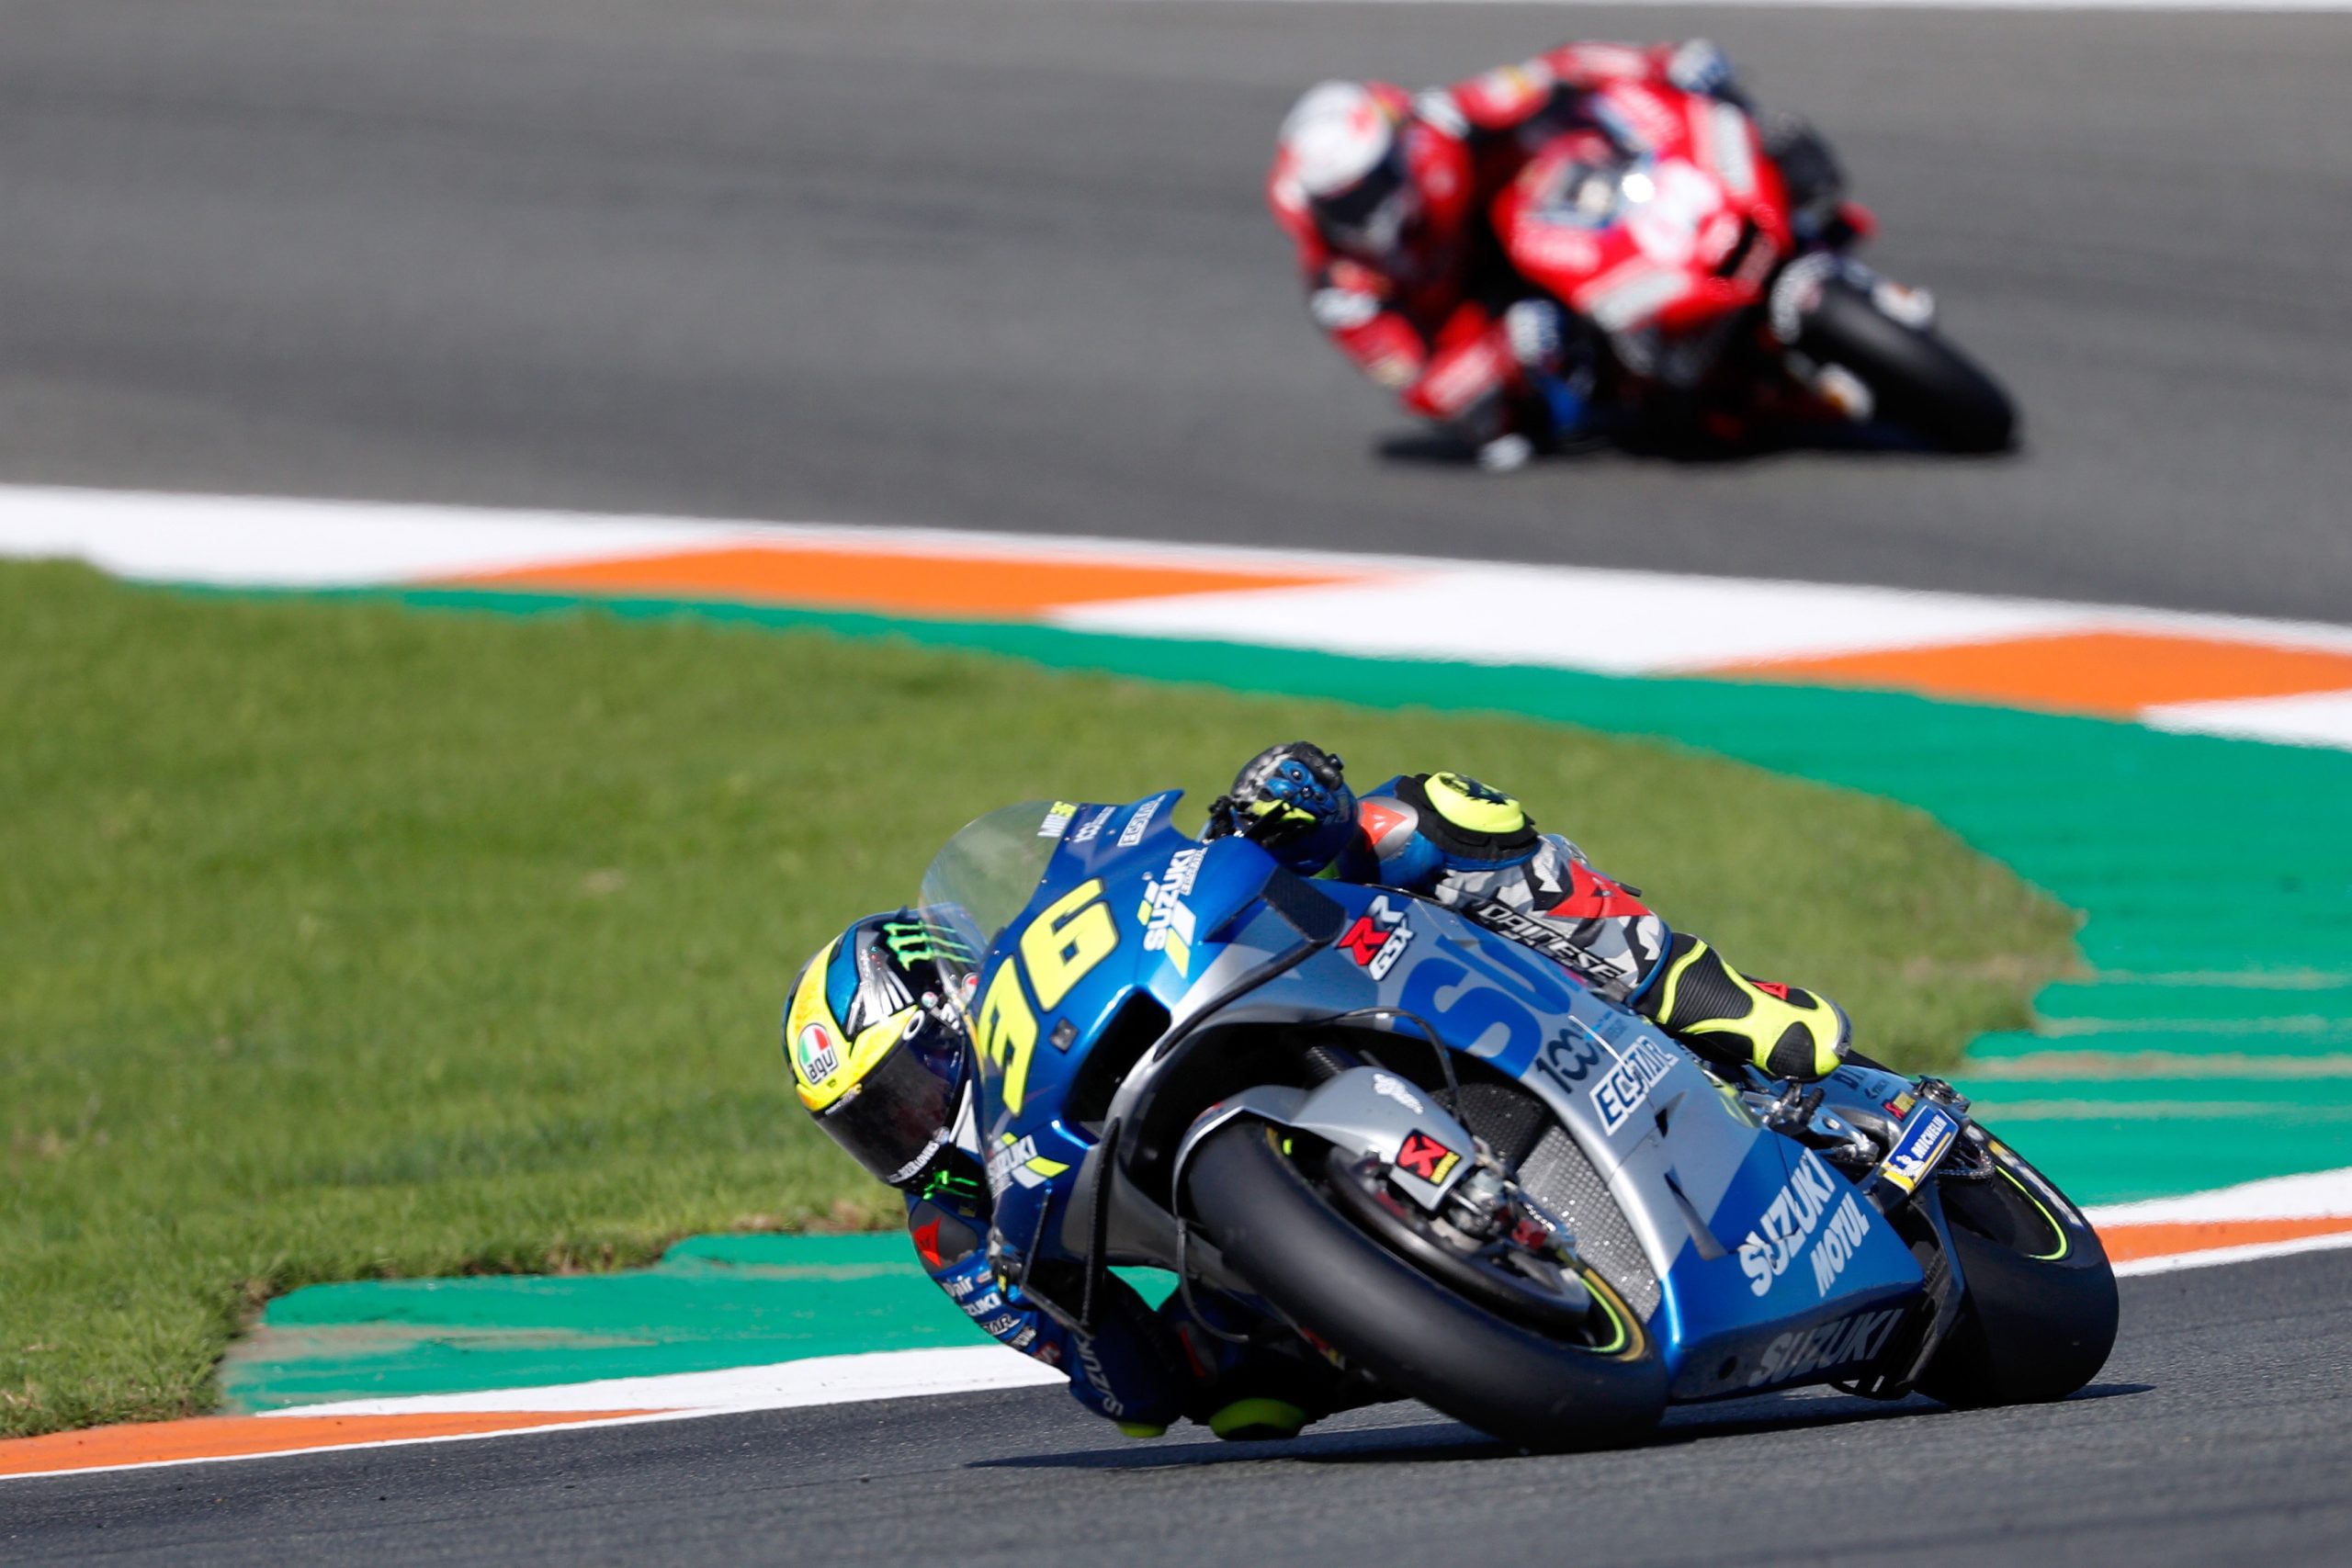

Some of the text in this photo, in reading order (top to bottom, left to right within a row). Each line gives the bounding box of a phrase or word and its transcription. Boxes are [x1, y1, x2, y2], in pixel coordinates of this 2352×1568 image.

[1143, 848, 1196, 952] SUZUKI
[1593, 1037, 1679, 1132] ECSTAR
[1910, 1113, 1948, 1160] MICHELIN
[1737, 1146, 1837, 1297] SUZUKI
[1809, 1191, 1871, 1298] MOTUL
[1747, 1308, 1905, 1389] SUZUKI
